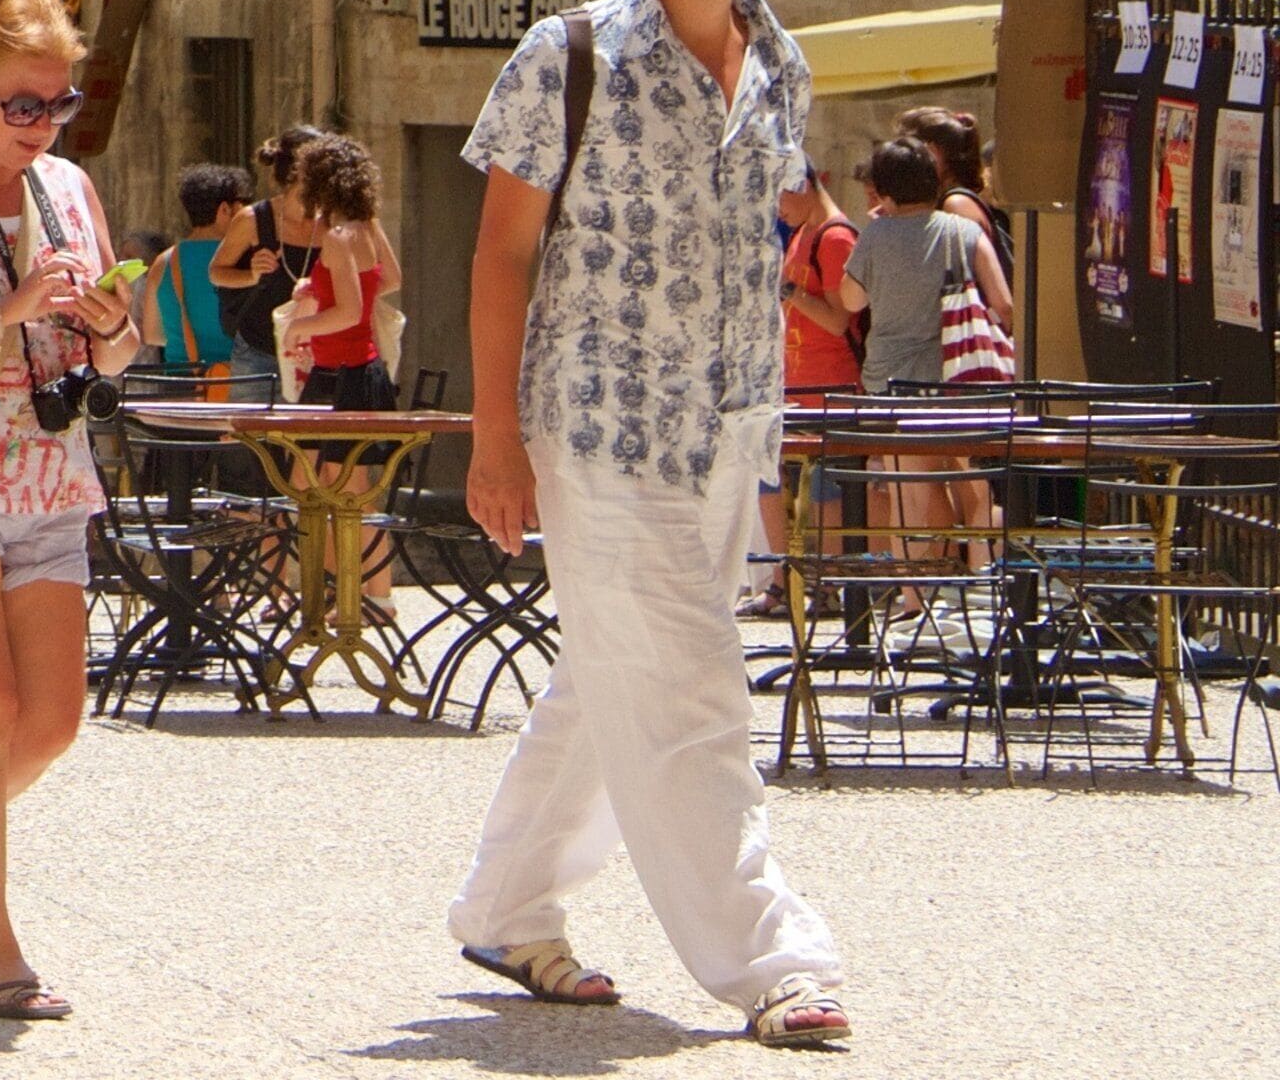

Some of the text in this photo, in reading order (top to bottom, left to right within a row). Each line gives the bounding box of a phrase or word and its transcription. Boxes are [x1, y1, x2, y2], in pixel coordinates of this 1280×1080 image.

[1123, 24, 1149, 50] 10:35
[1172, 35, 1200, 63] 12:25
[1233, 50, 1263, 78] 14:15
